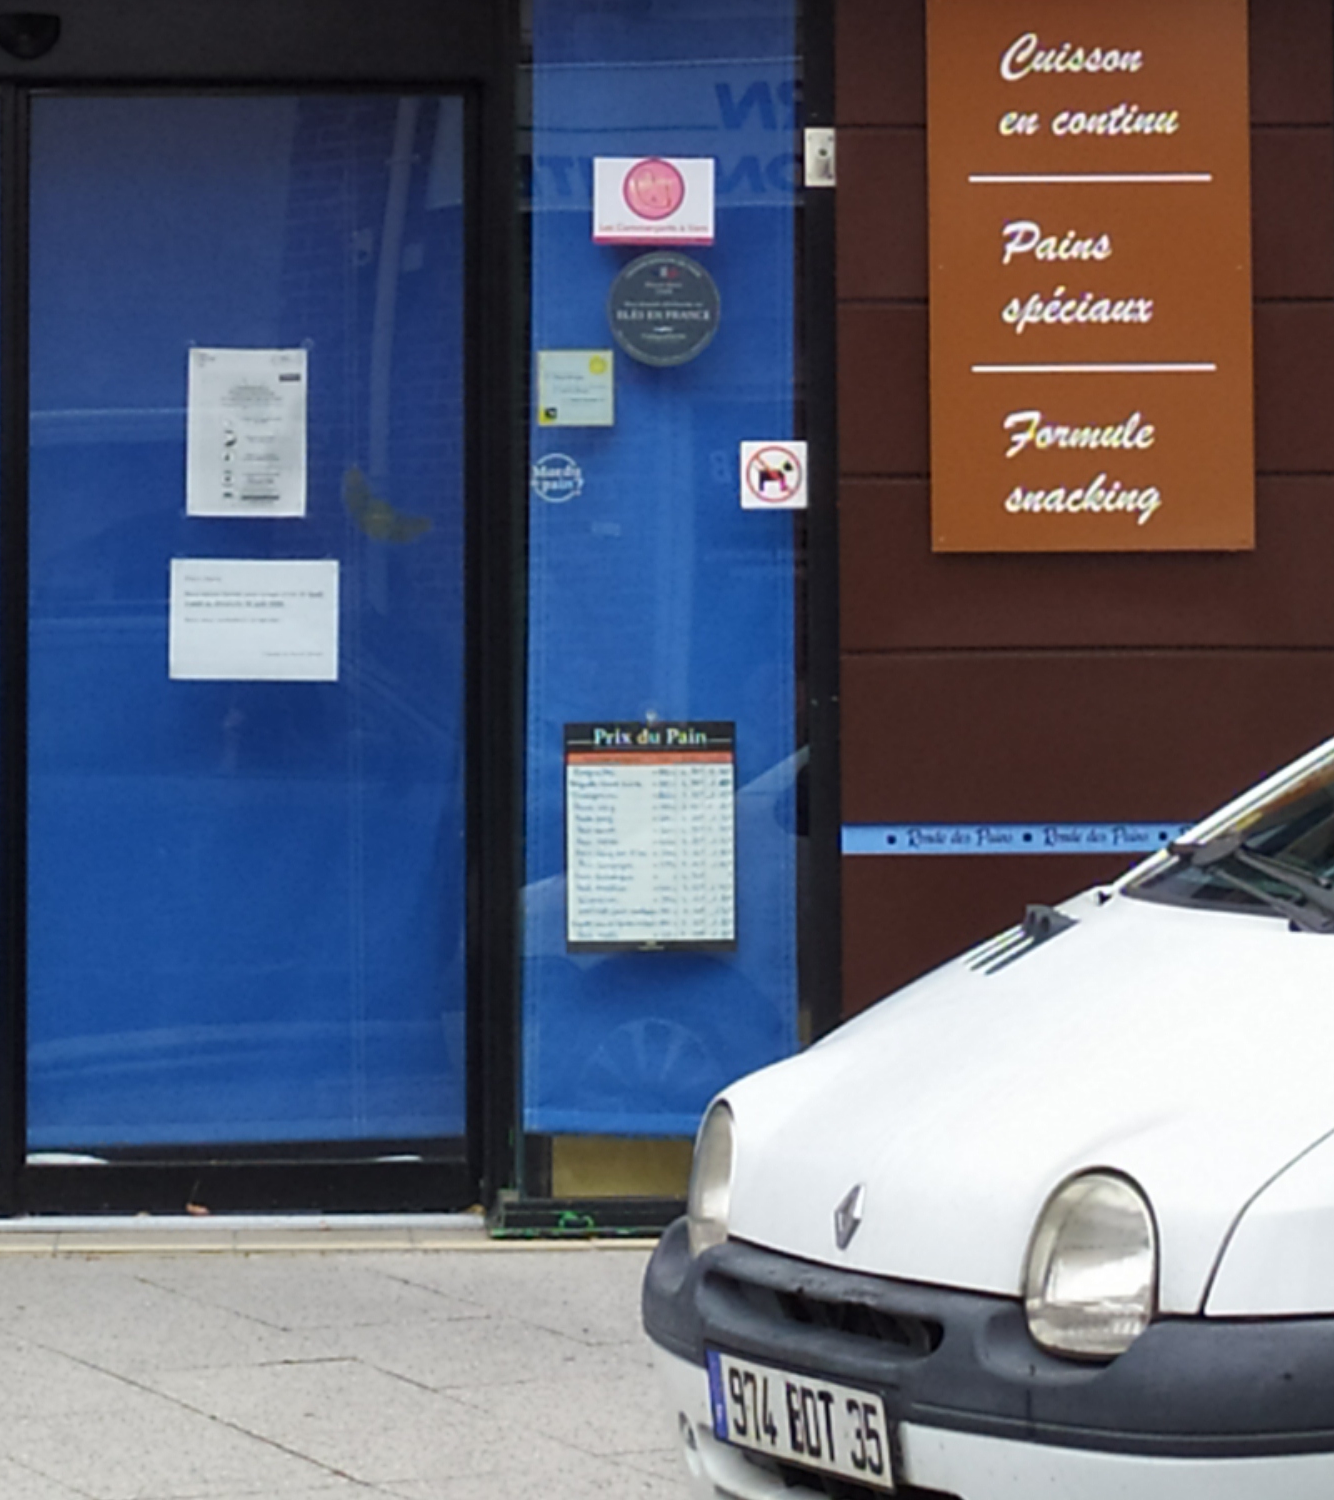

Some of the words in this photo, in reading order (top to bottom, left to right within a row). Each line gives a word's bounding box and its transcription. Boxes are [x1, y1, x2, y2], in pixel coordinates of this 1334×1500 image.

[1000, 33, 1143, 82] Cuisson
[999, 111, 1039, 135] en
[1052, 104, 1179, 136] continu
[1002, 221, 1112, 264] Pains
[1001, 286, 1153, 333] spéciaux
[1003, 410, 1155, 458] Formule
[1005, 474, 1162, 524] snacking
[594, 729, 632, 745] Prix
[637, 729, 661, 744] du
[667, 729, 707, 744] Pain
[729, 1368, 778, 1446] 974
[846, 1398, 883, 1475] 35
